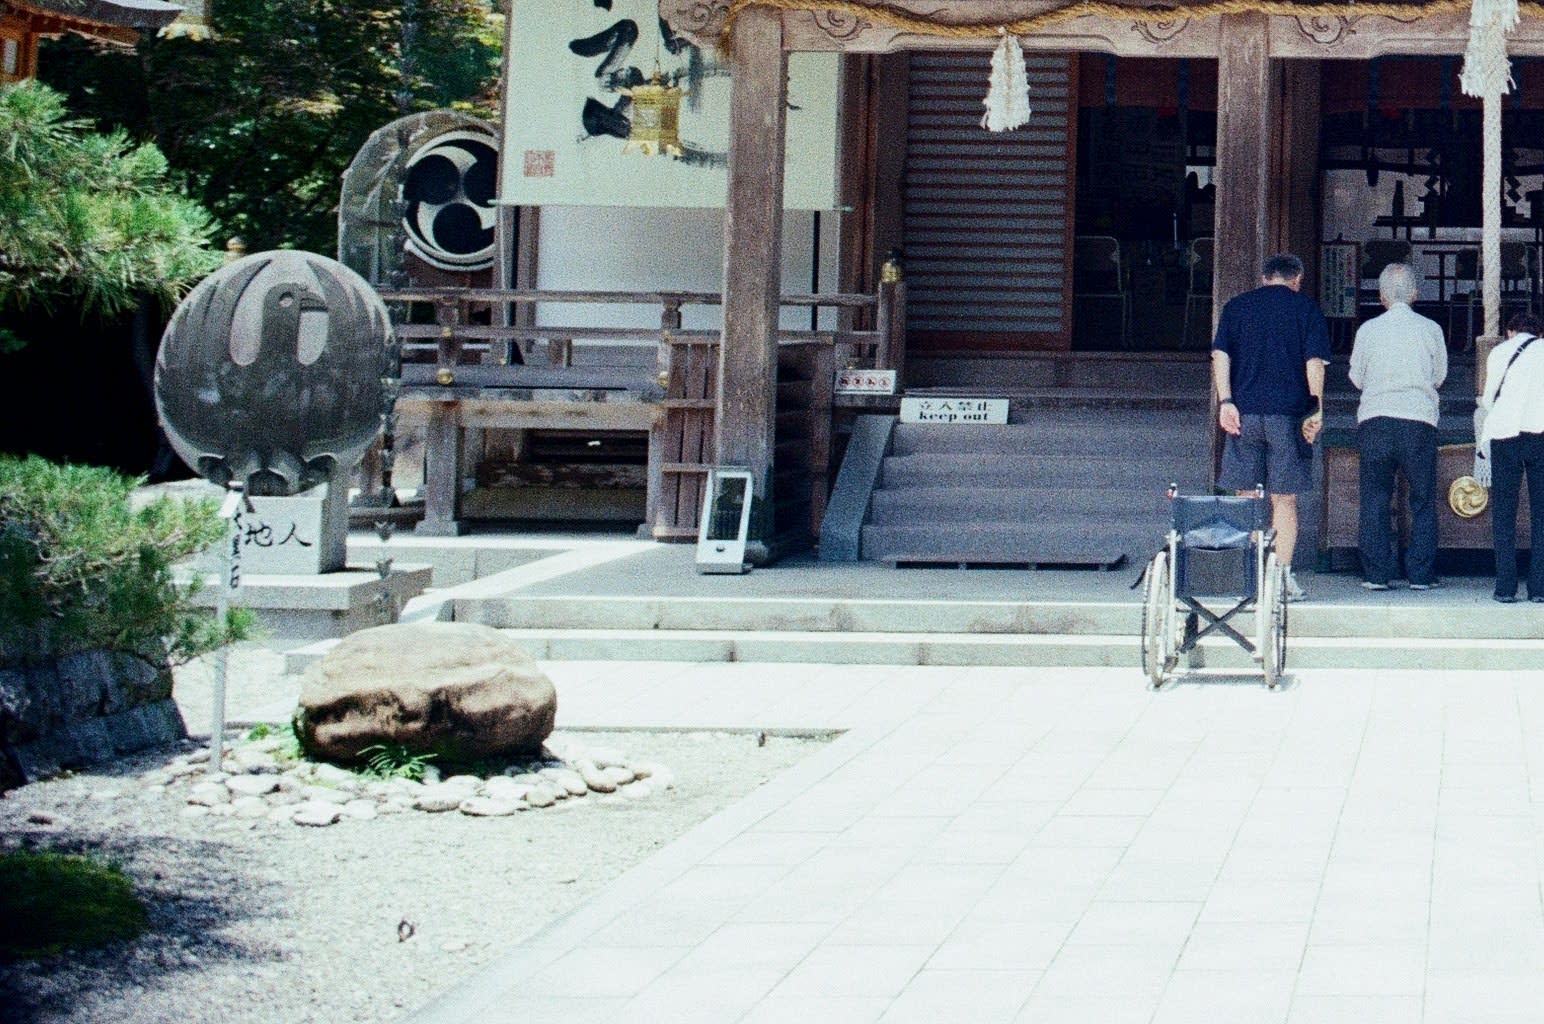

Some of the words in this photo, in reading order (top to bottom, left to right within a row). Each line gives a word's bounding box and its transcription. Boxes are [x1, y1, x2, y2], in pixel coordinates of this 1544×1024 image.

[919, 400, 992, 412] 立入禁止
[919, 411, 957, 422] keep
[963, 412, 988, 421] out
